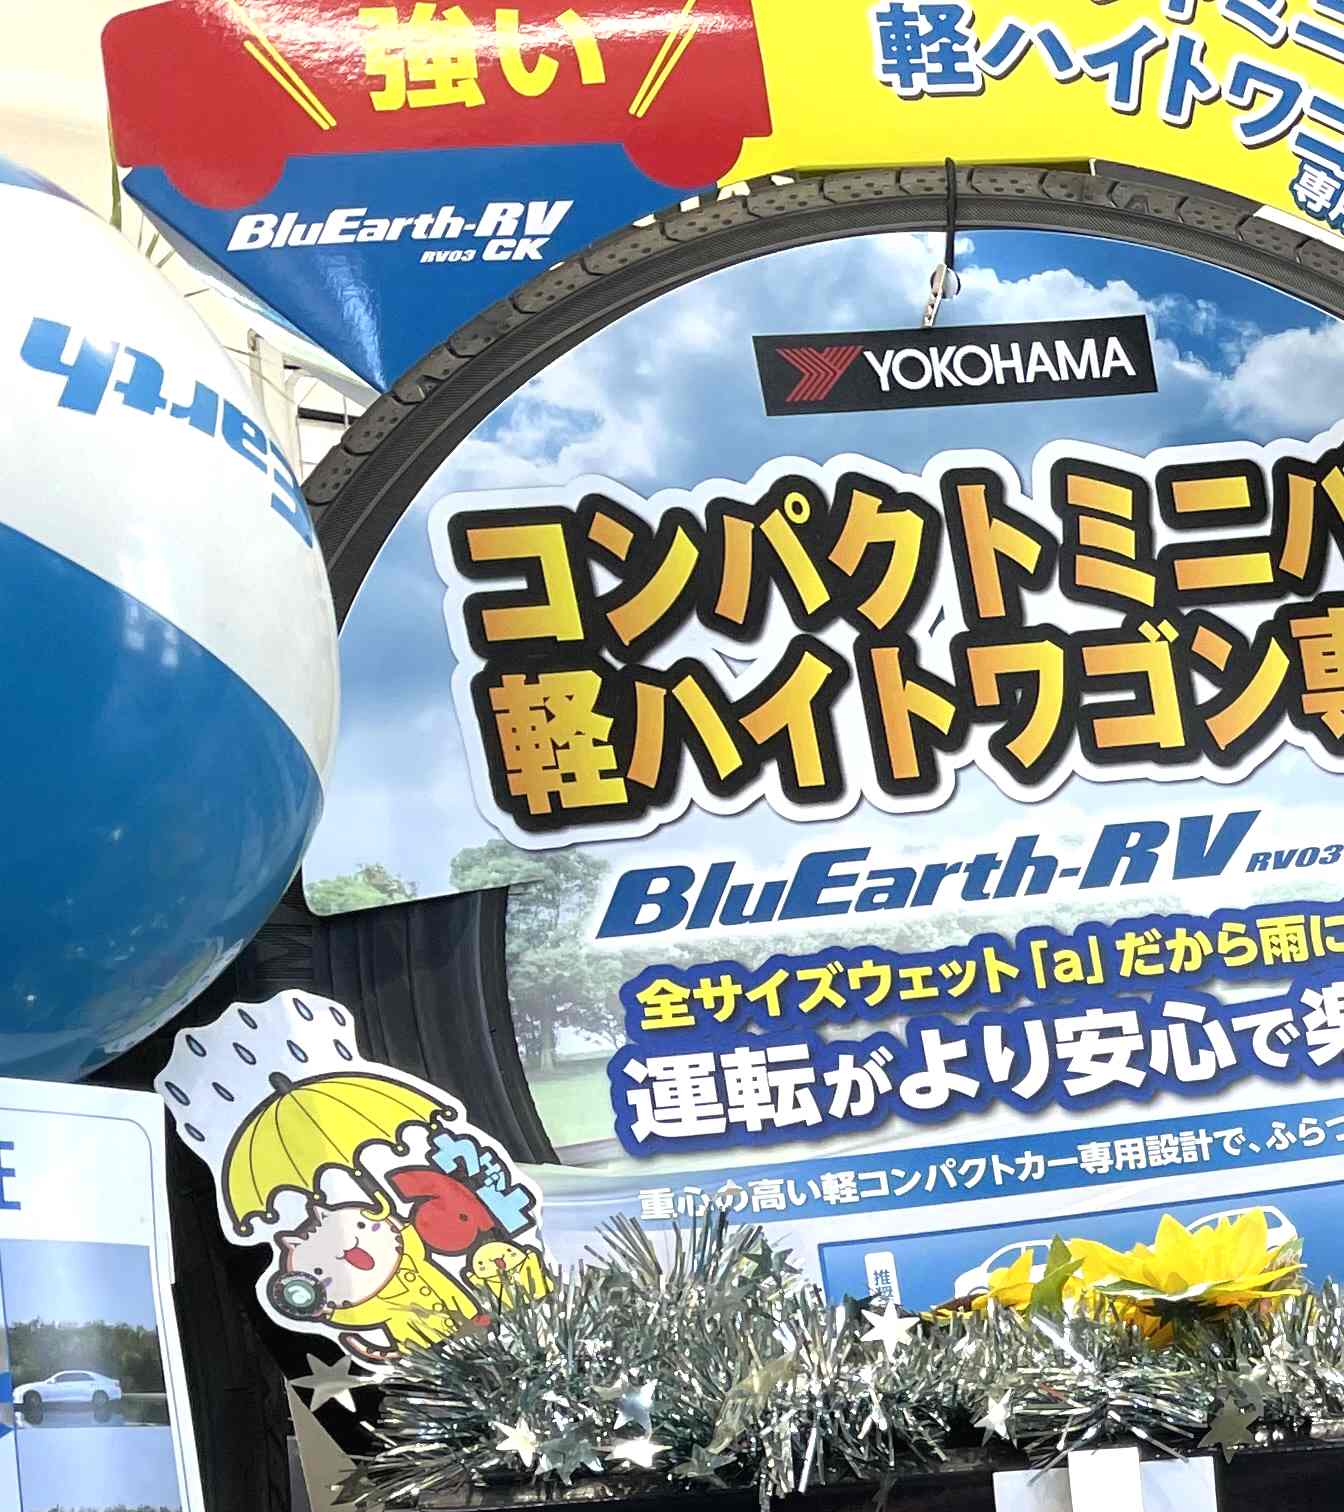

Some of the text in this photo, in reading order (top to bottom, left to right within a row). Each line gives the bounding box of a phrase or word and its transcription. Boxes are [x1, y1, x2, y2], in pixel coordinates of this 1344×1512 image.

[368, 2, 606, 112] 強い
[227, 200, 574, 252] BluEarth-RV
[420, 237, 547, 264] RV03 CK
[862, 337, 1136, 393] YOKOHAMA
[594, 810, 1262, 941] BluEarth-RV
[1246, 844, 1343, 873] RV03
